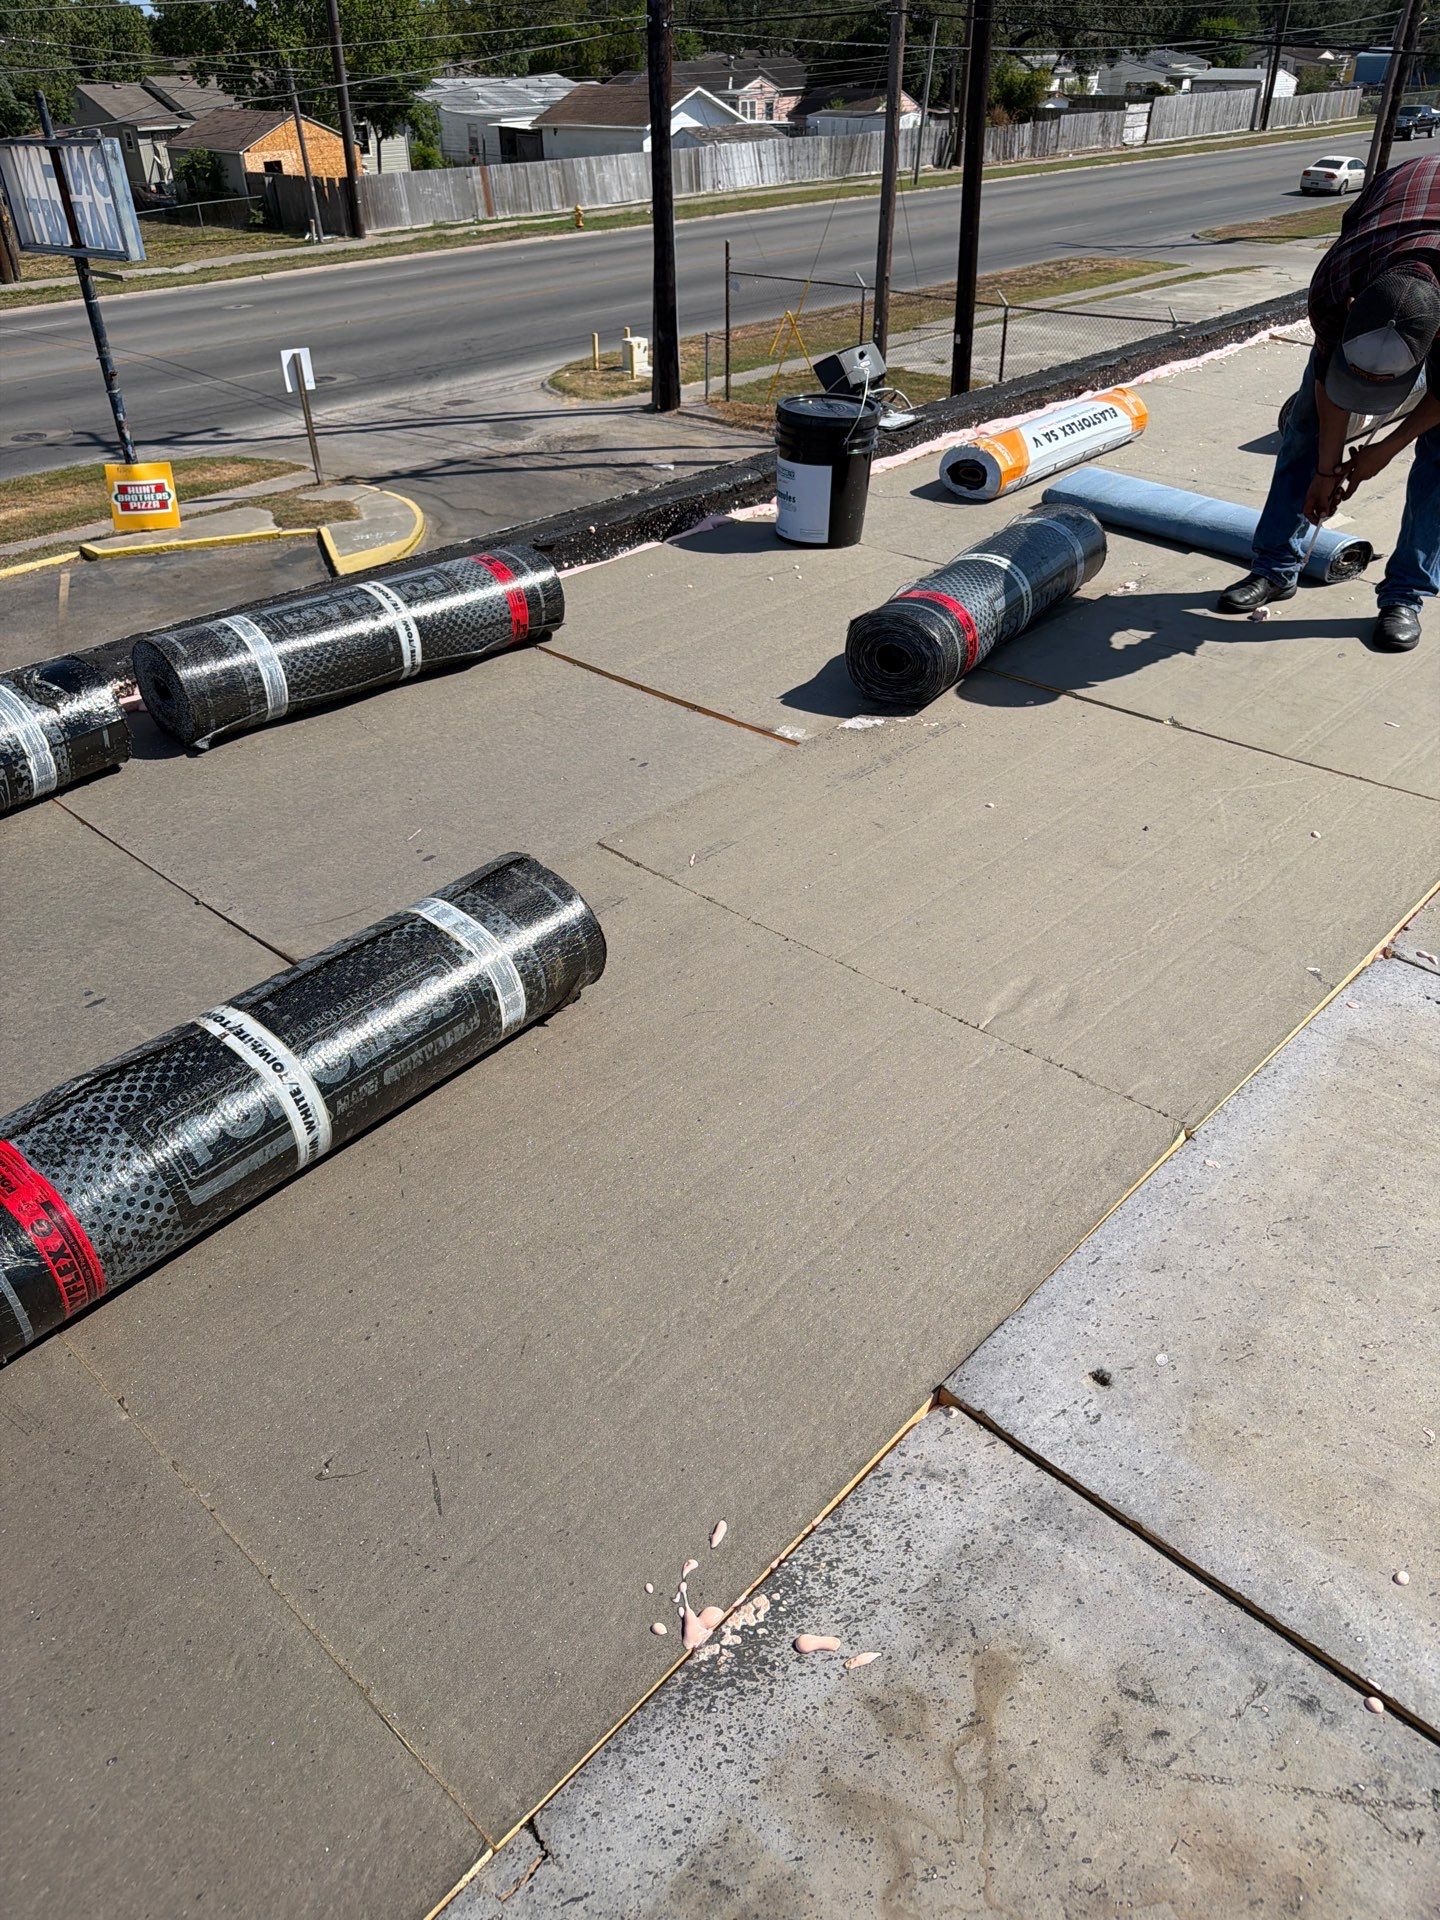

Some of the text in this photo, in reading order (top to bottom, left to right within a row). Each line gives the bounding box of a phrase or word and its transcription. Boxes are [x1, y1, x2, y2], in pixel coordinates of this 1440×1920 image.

[1062, 407, 1119, 437] ELASTOFLEX
[1041, 428, 1060, 444] SA
[127, 484, 157, 494] HUNT
[117, 492, 170, 502] BROTHERS
[129, 500, 161, 510] PIZZA
